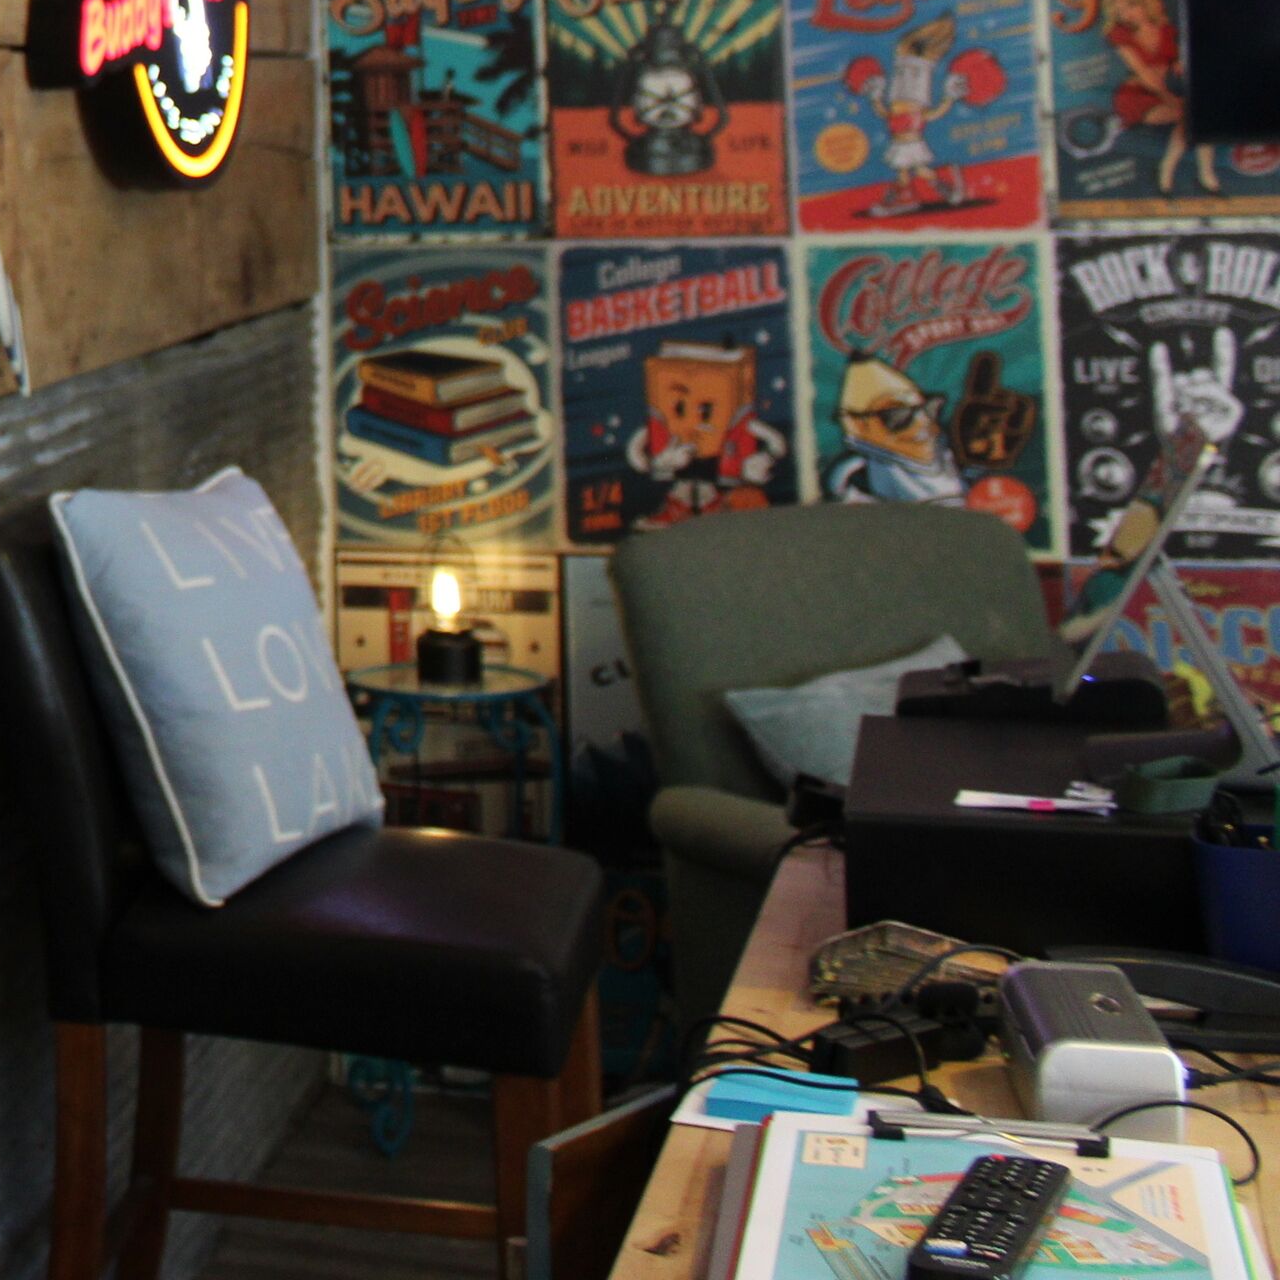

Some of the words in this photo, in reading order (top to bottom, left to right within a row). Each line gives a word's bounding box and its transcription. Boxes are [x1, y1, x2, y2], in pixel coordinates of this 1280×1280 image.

[341, 181, 535, 225] HAWAII
[567, 182, 770, 217] ADVENTURE
[596, 254, 682, 290] College
[819, 245, 1032, 354] College
[1071, 242, 1176, 314] ROCK
[343, 263, 539, 353] Science
[566, 260, 786, 343] BASKETBALL
[1073, 355, 1139, 384] LIVE
